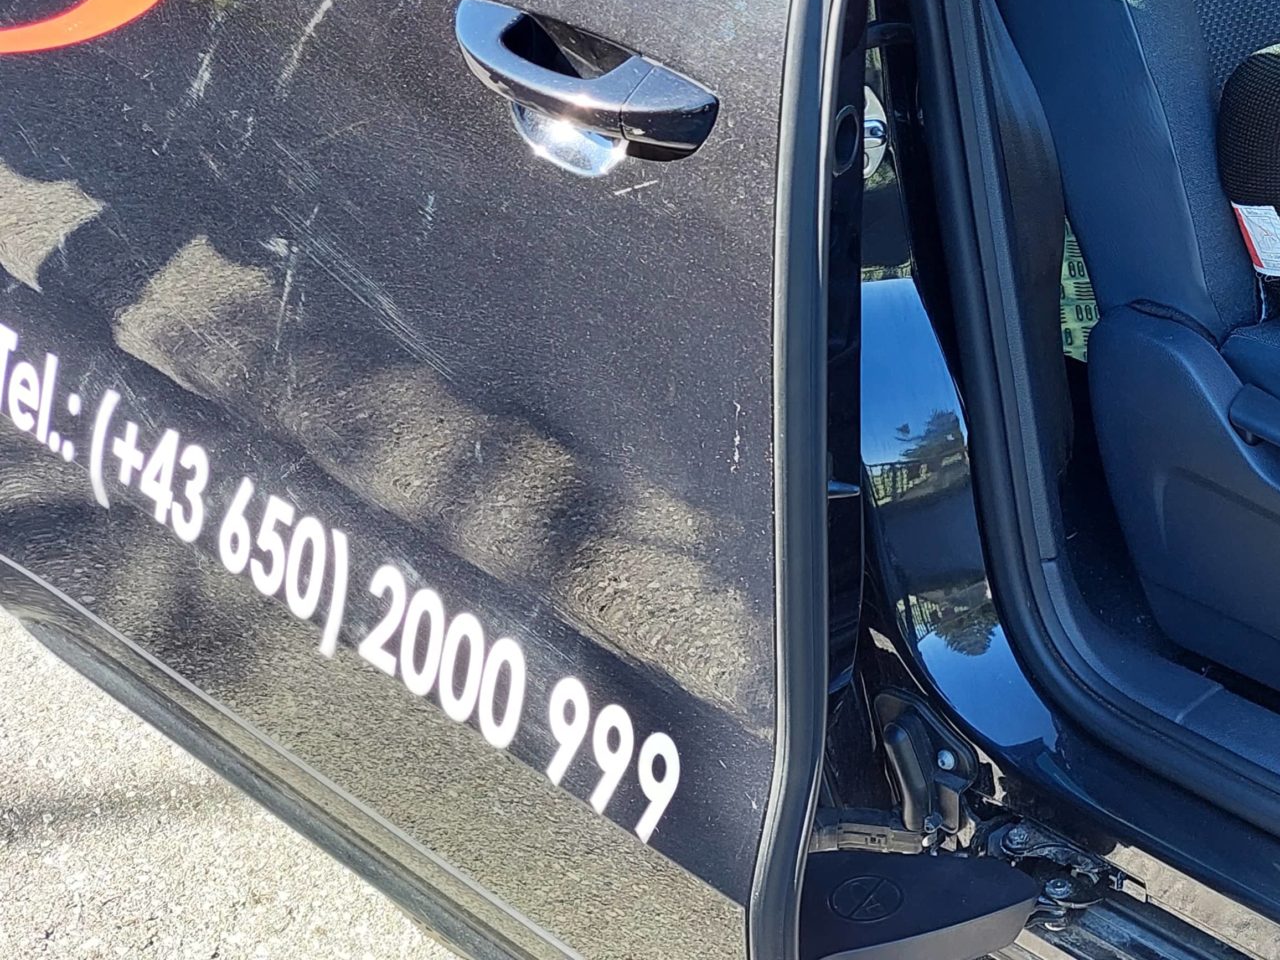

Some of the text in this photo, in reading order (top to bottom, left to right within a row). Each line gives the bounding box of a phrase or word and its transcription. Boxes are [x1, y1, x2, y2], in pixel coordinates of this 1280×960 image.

[89, 389, 210, 543] (+43
[218, 477, 348, 659] 650)
[358, 565, 527, 749] 2000
[545, 676, 681, 845] 999
